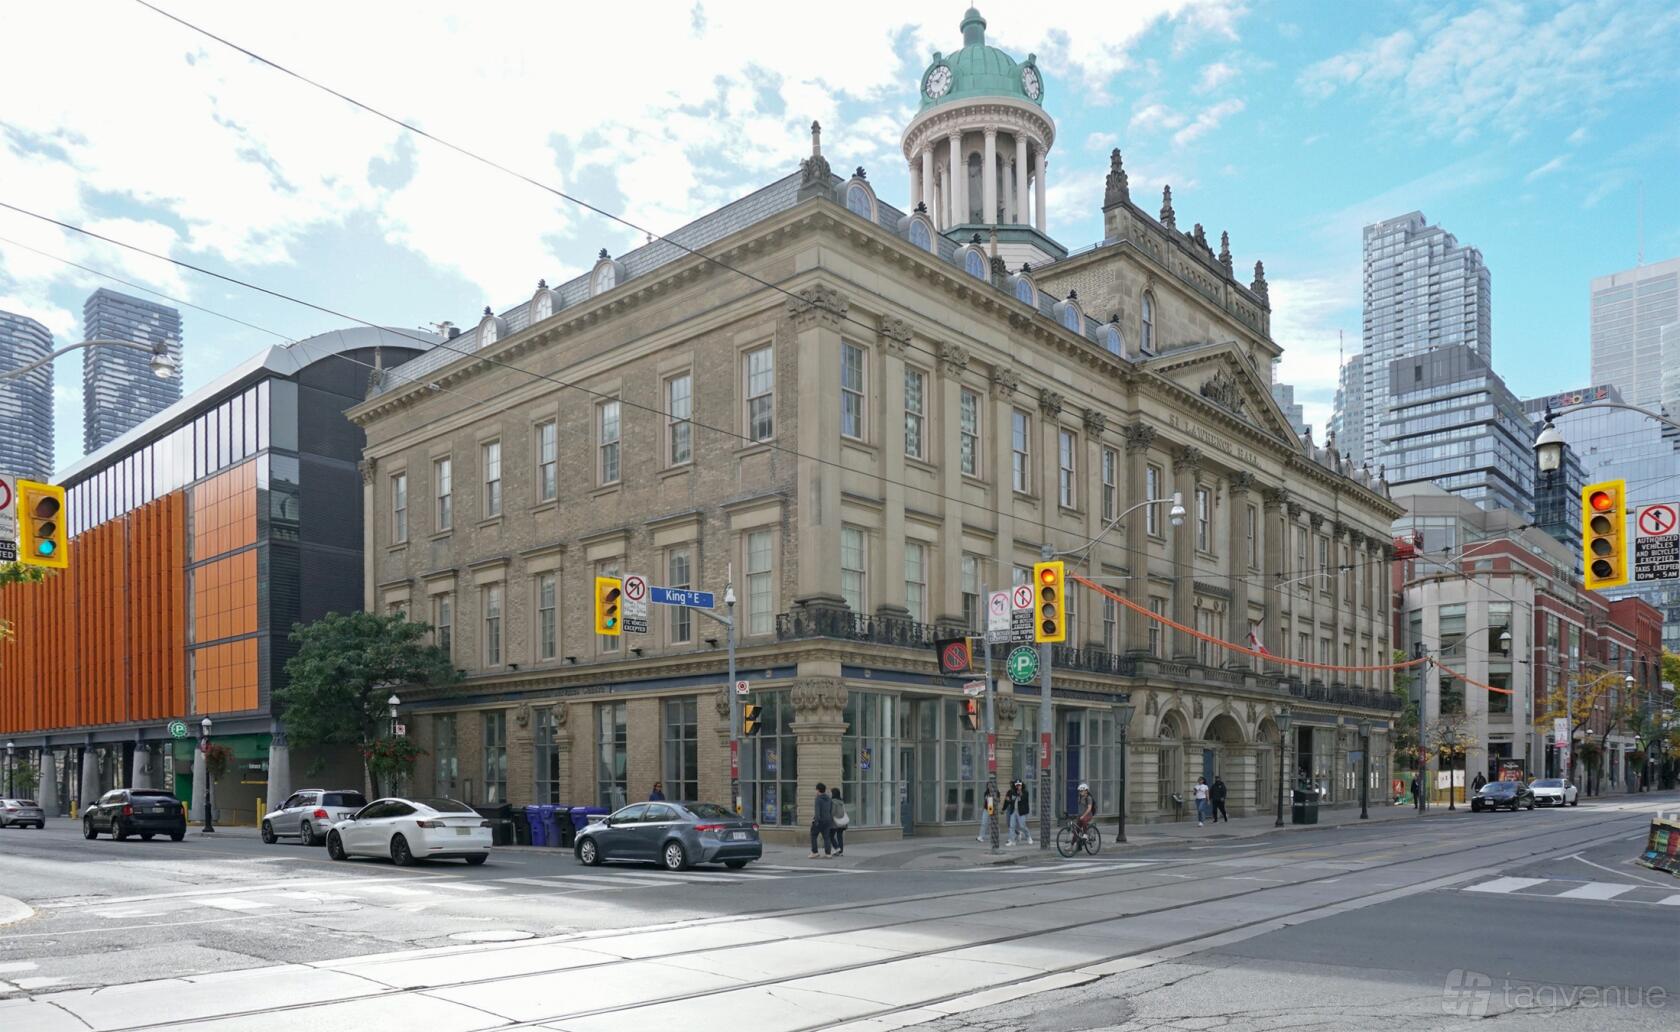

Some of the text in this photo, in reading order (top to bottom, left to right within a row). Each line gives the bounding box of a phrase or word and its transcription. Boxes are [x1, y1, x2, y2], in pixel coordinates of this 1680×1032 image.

[1184, 421, 1233, 455] LAWRENCE
[1237, 446, 1265, 469] HALL
[1637, 535, 1678, 544] AUTHORIZED
[1641, 542, 1674, 550] VEHICLES
[1651, 548, 1678, 556] BICYCLES
[1641, 555, 1675, 564] EXCEPTED
[1635, 563, 1680, 573] TAXIS EXCEPTED
[665, 589, 686, 605] King
[694, 593, 700, 604] E
[1017, 656, 1030, 672] P
